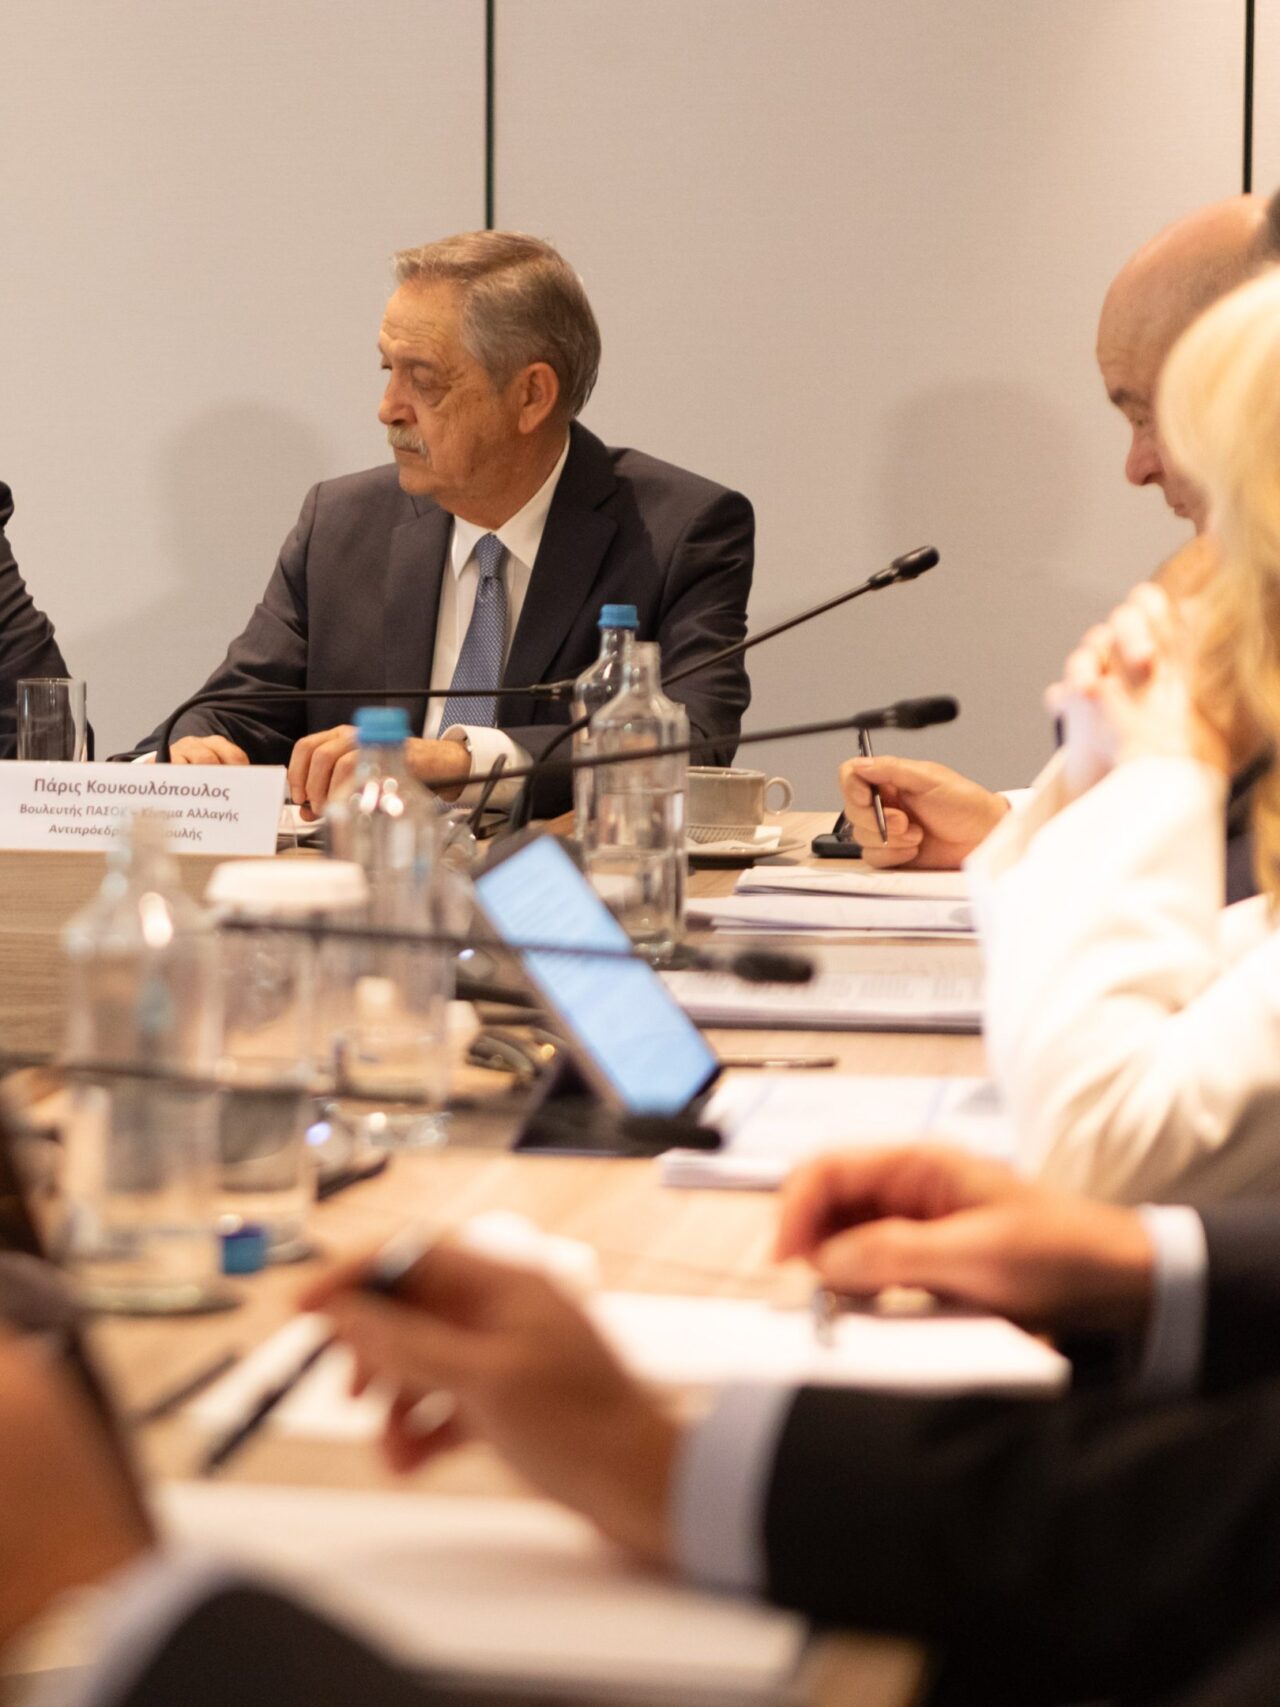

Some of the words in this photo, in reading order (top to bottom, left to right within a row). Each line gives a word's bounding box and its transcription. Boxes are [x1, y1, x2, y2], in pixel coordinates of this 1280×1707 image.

[34, 777, 82, 796] Πάρις
[86, 779, 231, 801] Κουκουλόπουλος
[19, 803, 83, 818] Βουλευτής
[186, 807, 240, 822] Αλλαγής
[48, 823, 130, 839] Αντιπρόεδρ
[158, 826, 203, 841] ουλής
